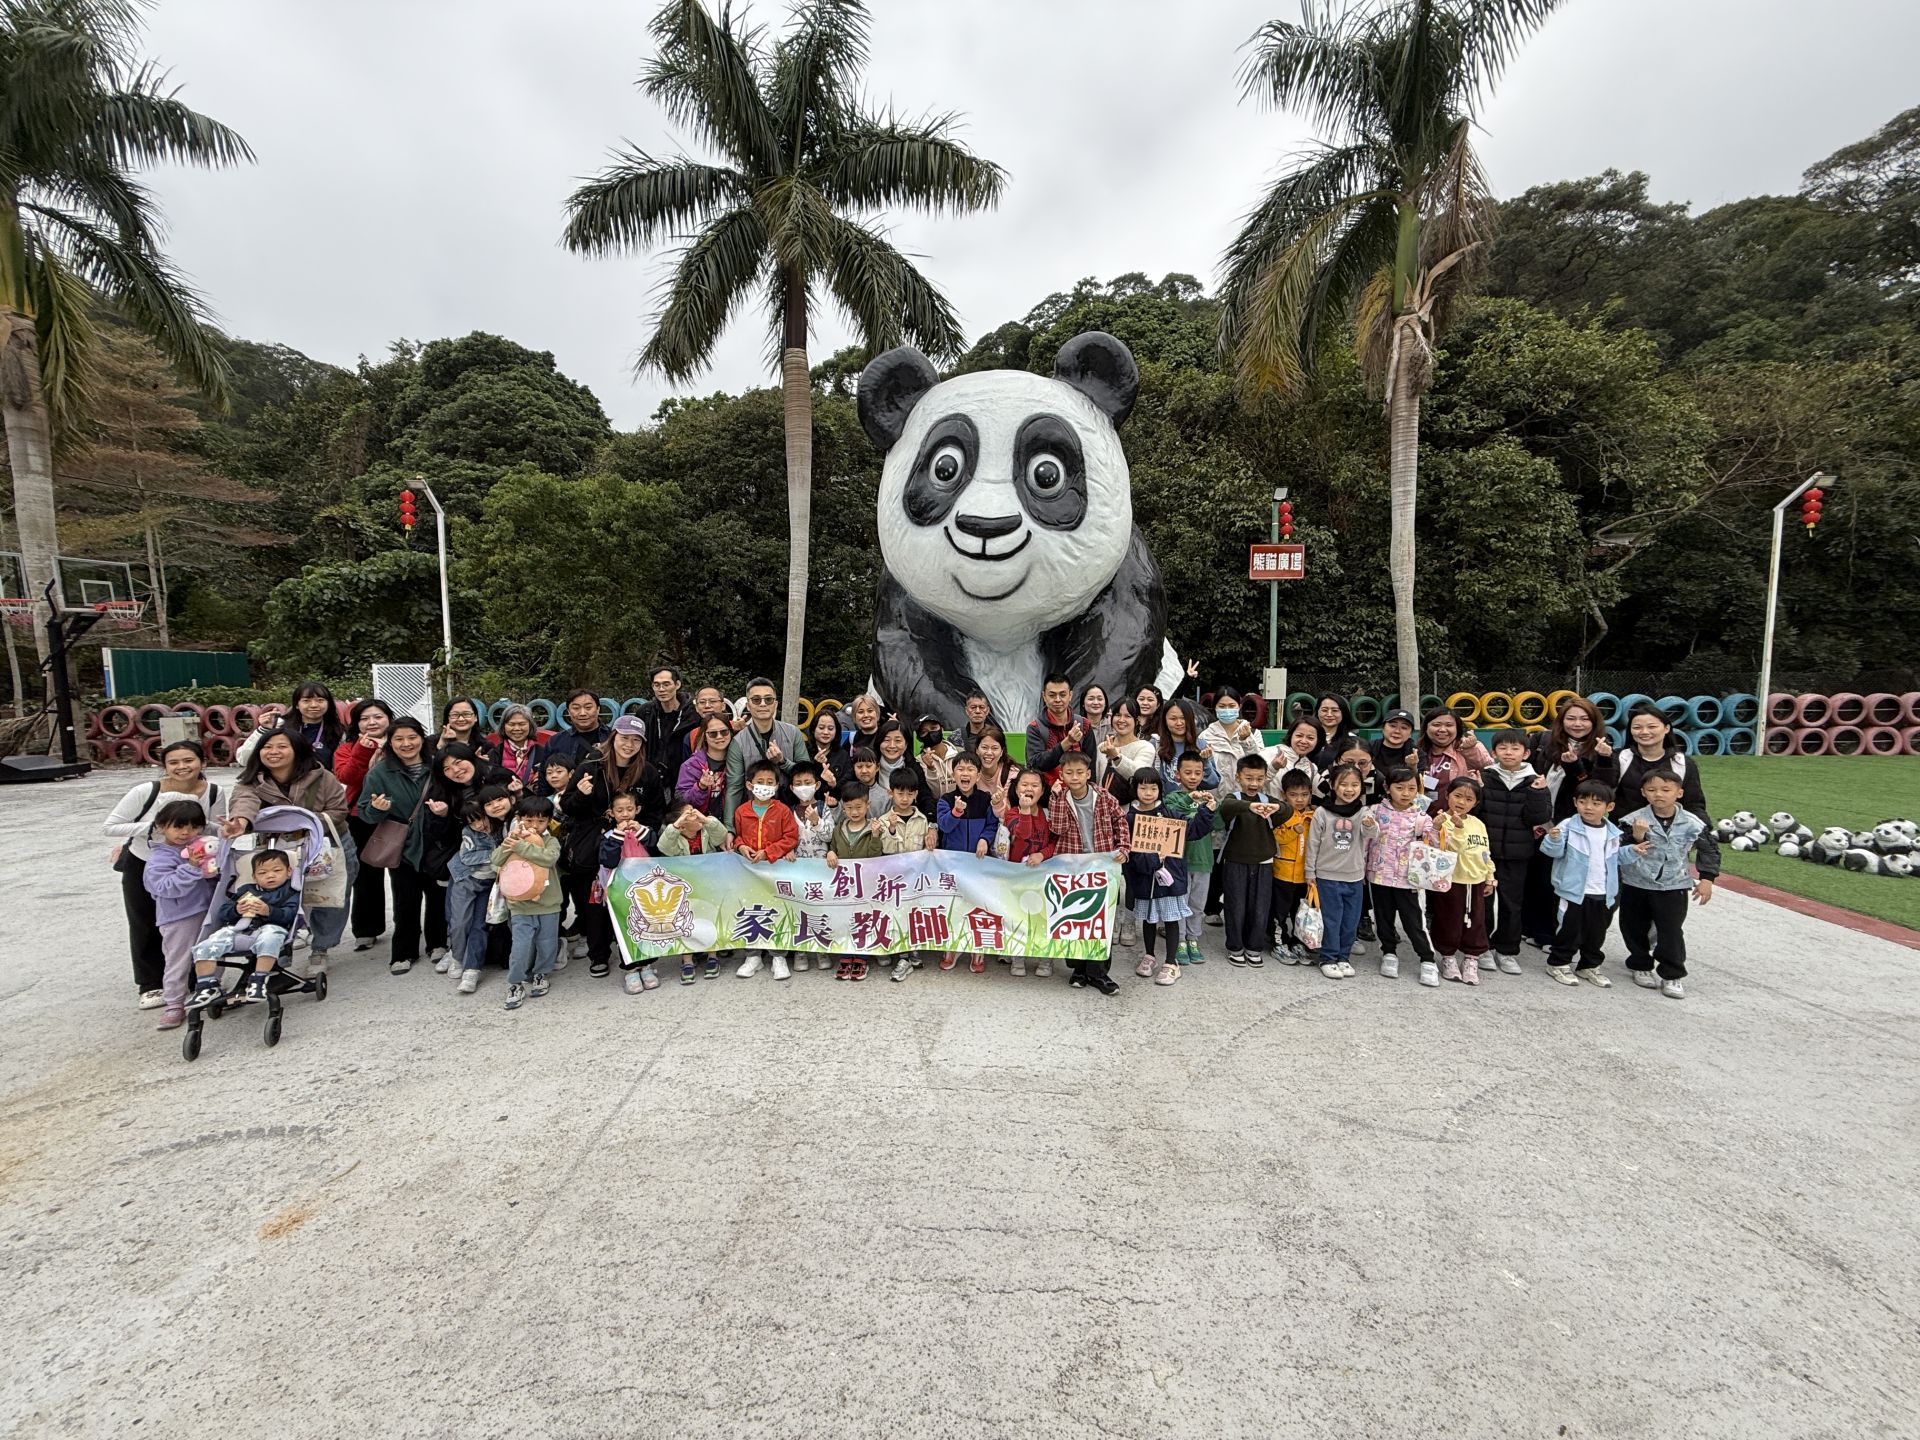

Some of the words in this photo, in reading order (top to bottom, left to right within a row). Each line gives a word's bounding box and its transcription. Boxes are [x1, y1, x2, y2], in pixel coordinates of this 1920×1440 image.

[1253, 553, 1302, 571] 熊貓廣場
[1171, 828, 1181, 855] 1
[1467, 834, 1488, 847] NGELE
[775, 863, 958, 907] 鳳溪創新小學
[734, 905, 1004, 949] 家長教師會
[1052, 903, 1106, 940] PTA
